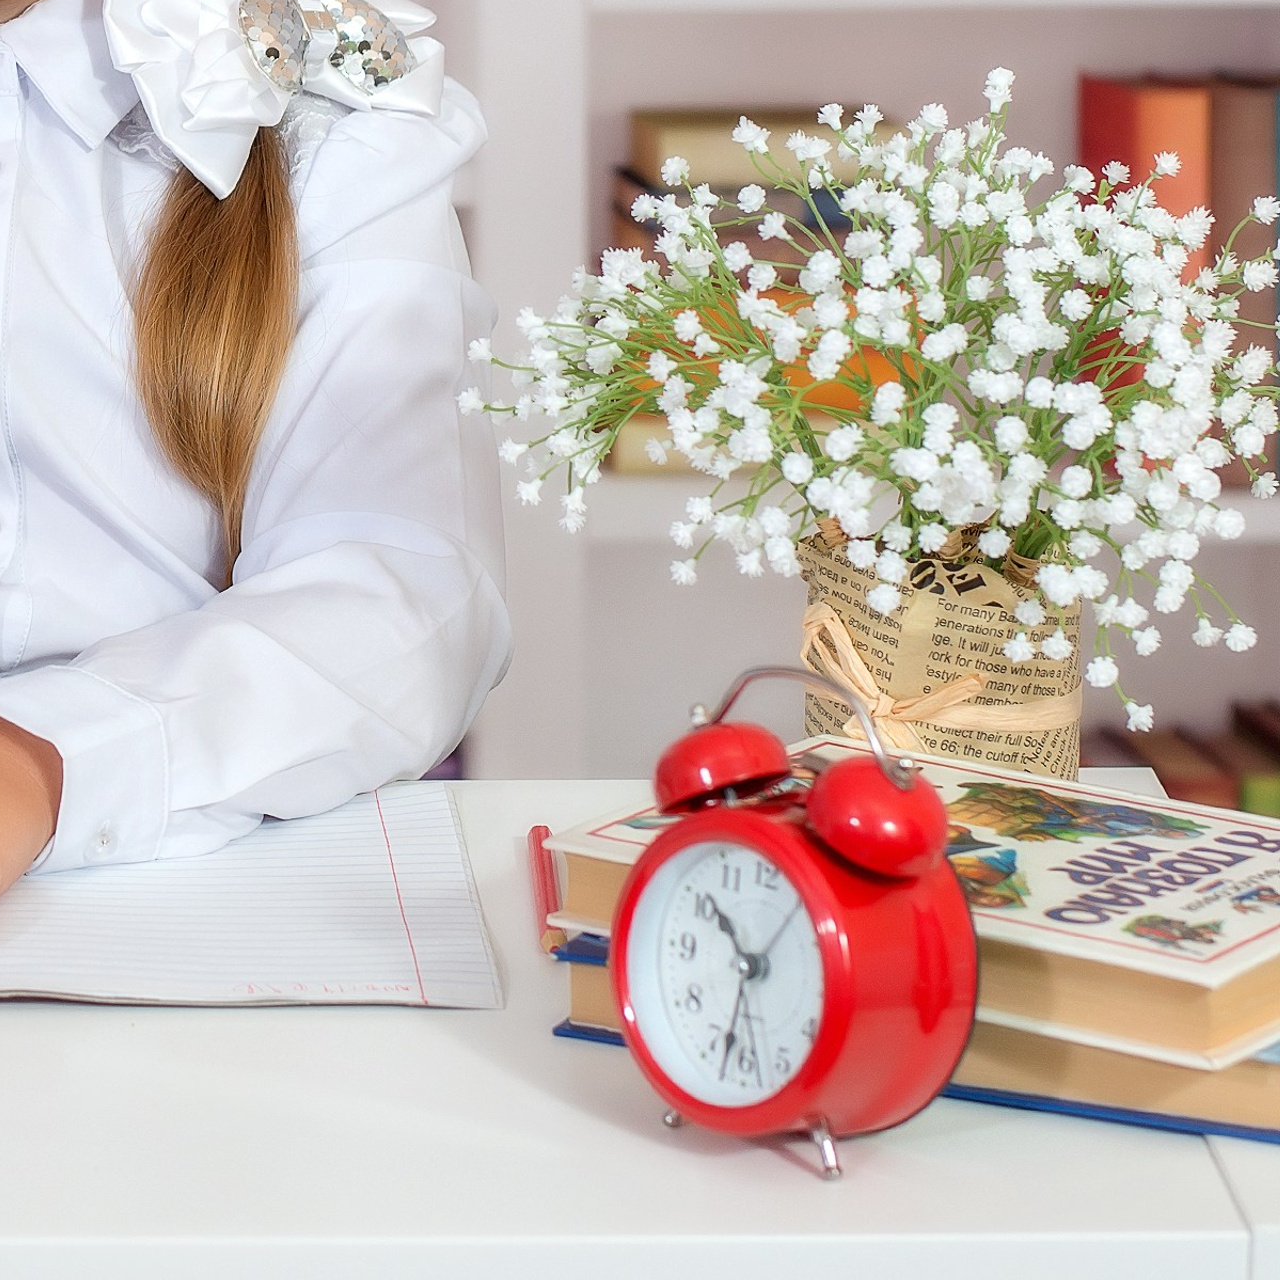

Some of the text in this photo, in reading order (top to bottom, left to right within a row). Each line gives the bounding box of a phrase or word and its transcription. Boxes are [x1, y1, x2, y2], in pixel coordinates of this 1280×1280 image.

[960, 605, 996, 623] many
[872, 630, 899, 648] team
[958, 636, 967, 650] It
[970, 641, 990, 653] will
[875, 667, 892, 682] his
[955, 653, 973, 668] for
[974, 658, 1008, 674] those
[1010, 664, 1033, 678] who
[1034, 665, 1056, 678] have
[985, 680, 1019, 696] many
[1020, 682, 1033, 695] of
[1033, 684, 1056, 697] those
[976, 730, 1003, 744] their
[1005, 733, 1023, 747] full
[963, 744, 983, 759] the
[985, 750, 1020, 764] cutoff
[722, 863, 741, 892] 11
[754, 860, 781, 891] 12
[1047, 840, 1172, 886] МИР
[1043, 846, 1256, 924] ПОЗНАЮ
[694, 891, 719, 920] 10
[679, 931, 697, 960] 9
[684, 982, 703, 1013] 8
[708, 1022, 723, 1052] 7
[737, 1045, 756, 1074] 6
[775, 1046, 791, 1075] 5
